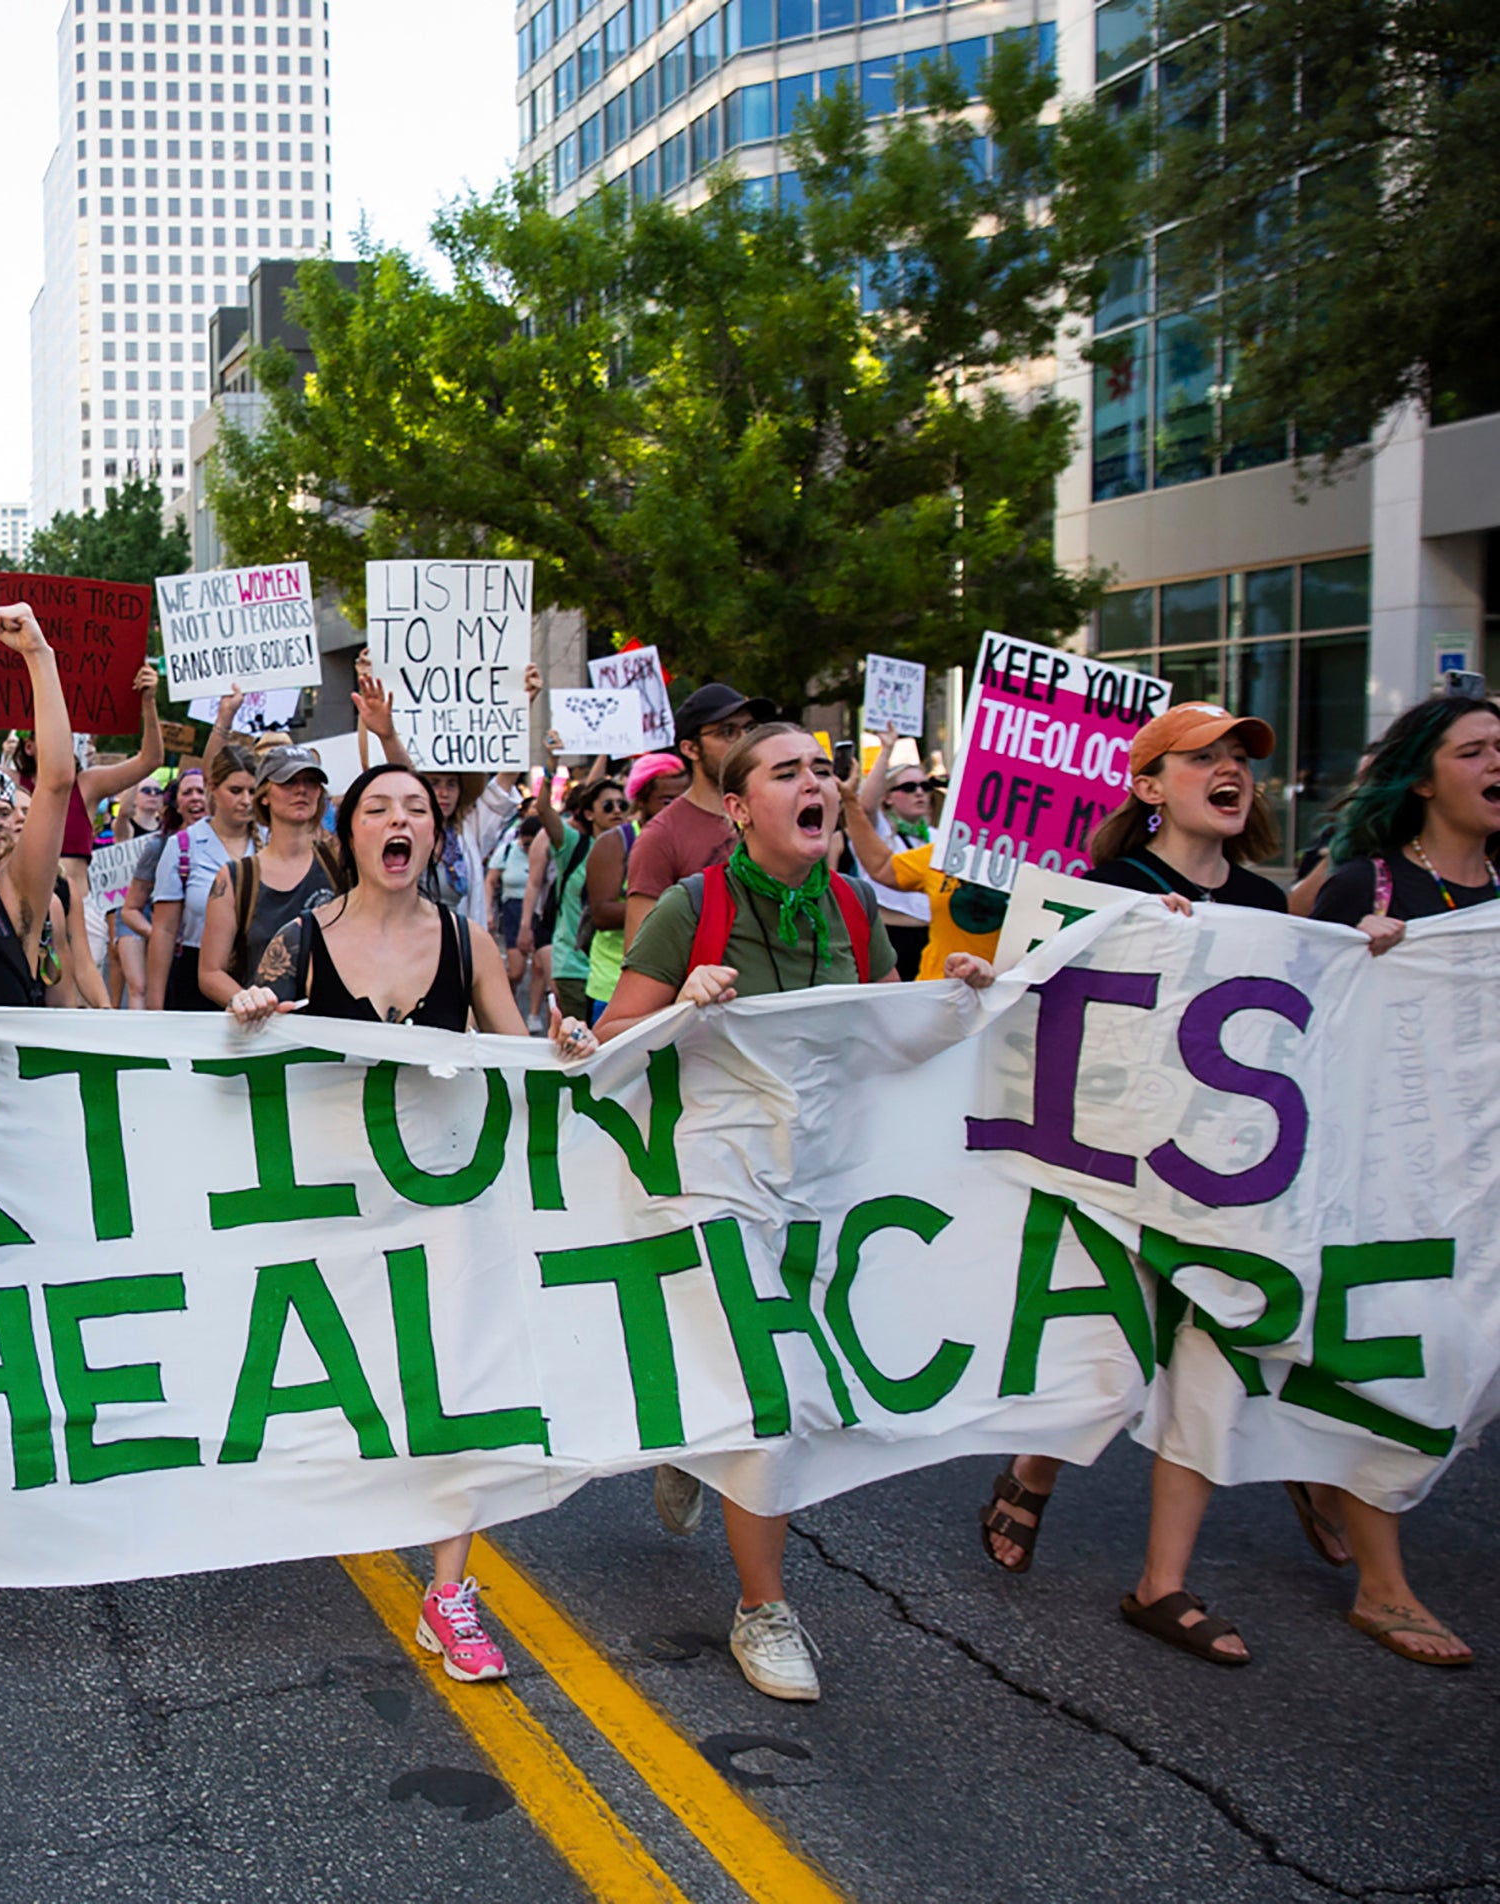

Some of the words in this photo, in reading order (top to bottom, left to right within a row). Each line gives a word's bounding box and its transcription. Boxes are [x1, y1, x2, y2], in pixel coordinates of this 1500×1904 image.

[84, 587, 144, 621] TIRED
[161, 581, 194, 614] WE
[199, 575, 236, 609] ARE
[236, 568, 300, 603] WOMEN
[386, 563, 528, 612] LISTEN
[84, 620, 115, 648] FOR
[171, 612, 211, 644] NOT
[217, 600, 314, 639] UTERUSES
[370, 617, 431, 664] TO
[457, 616, 509, 663] MY
[55, 651, 73, 672] TO
[79, 652, 111, 676] MY
[171, 648, 212, 684] BANS
[212, 645, 233, 675] OFF
[234, 643, 262, 674] OUR
[400, 666, 509, 705] VOICE
[979, 638, 1070, 705] KEEP
[1084, 664, 1166, 728] YOUR
[432, 709, 460, 732] ME
[469, 708, 527, 732] HAVE
[432, 734, 521, 765] CHOICE
[979, 698, 1134, 792] THEOLOG
[977, 770, 1054, 838] OFF
[964, 966, 1315, 1209] IS
